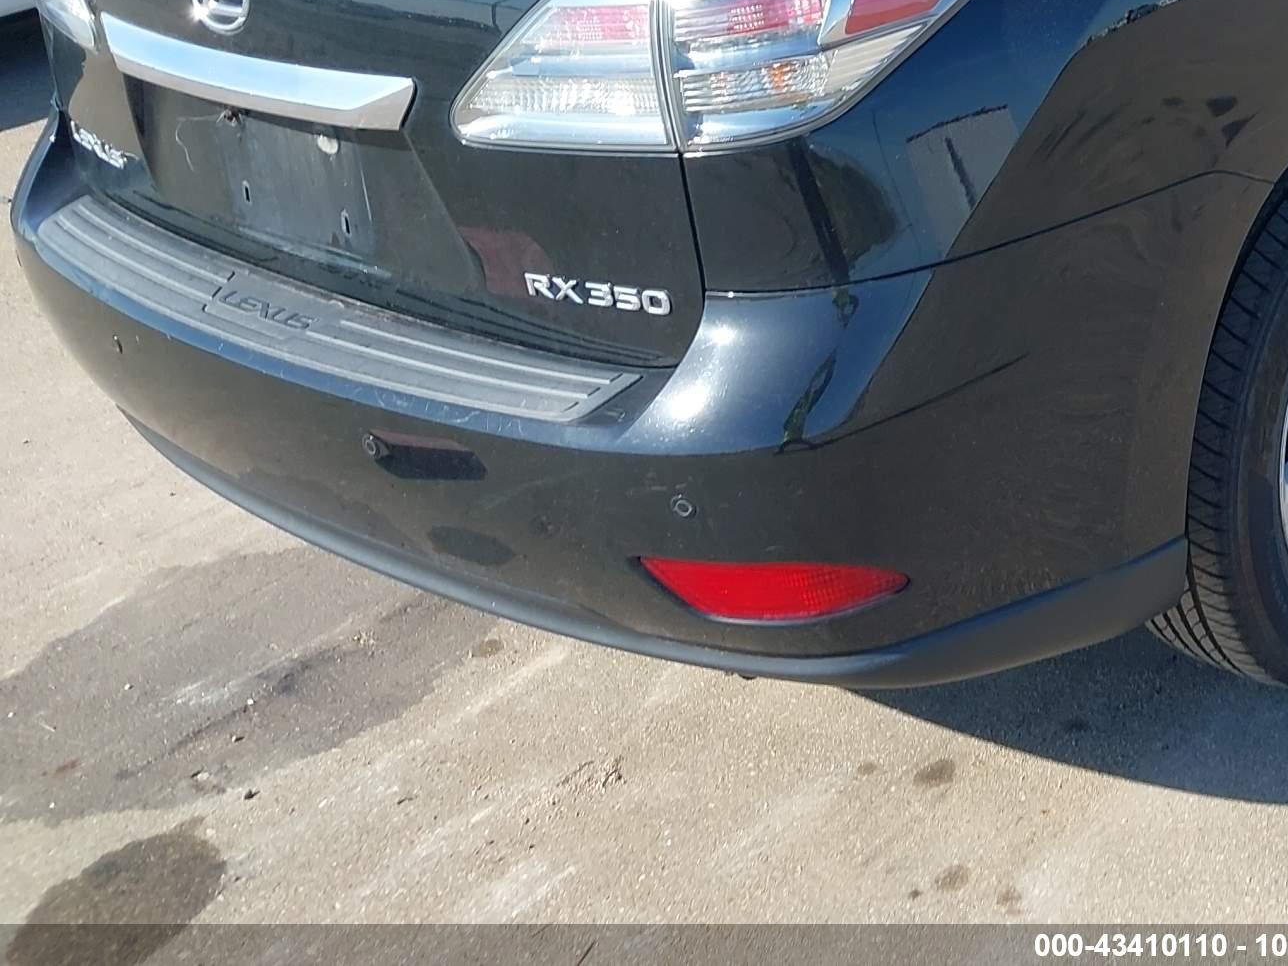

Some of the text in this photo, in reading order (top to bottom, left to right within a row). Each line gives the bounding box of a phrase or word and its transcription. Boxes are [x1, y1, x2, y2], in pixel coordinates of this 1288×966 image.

[219, 290, 317, 330] LEXUS
[524, 272, 672, 316] RX 350
